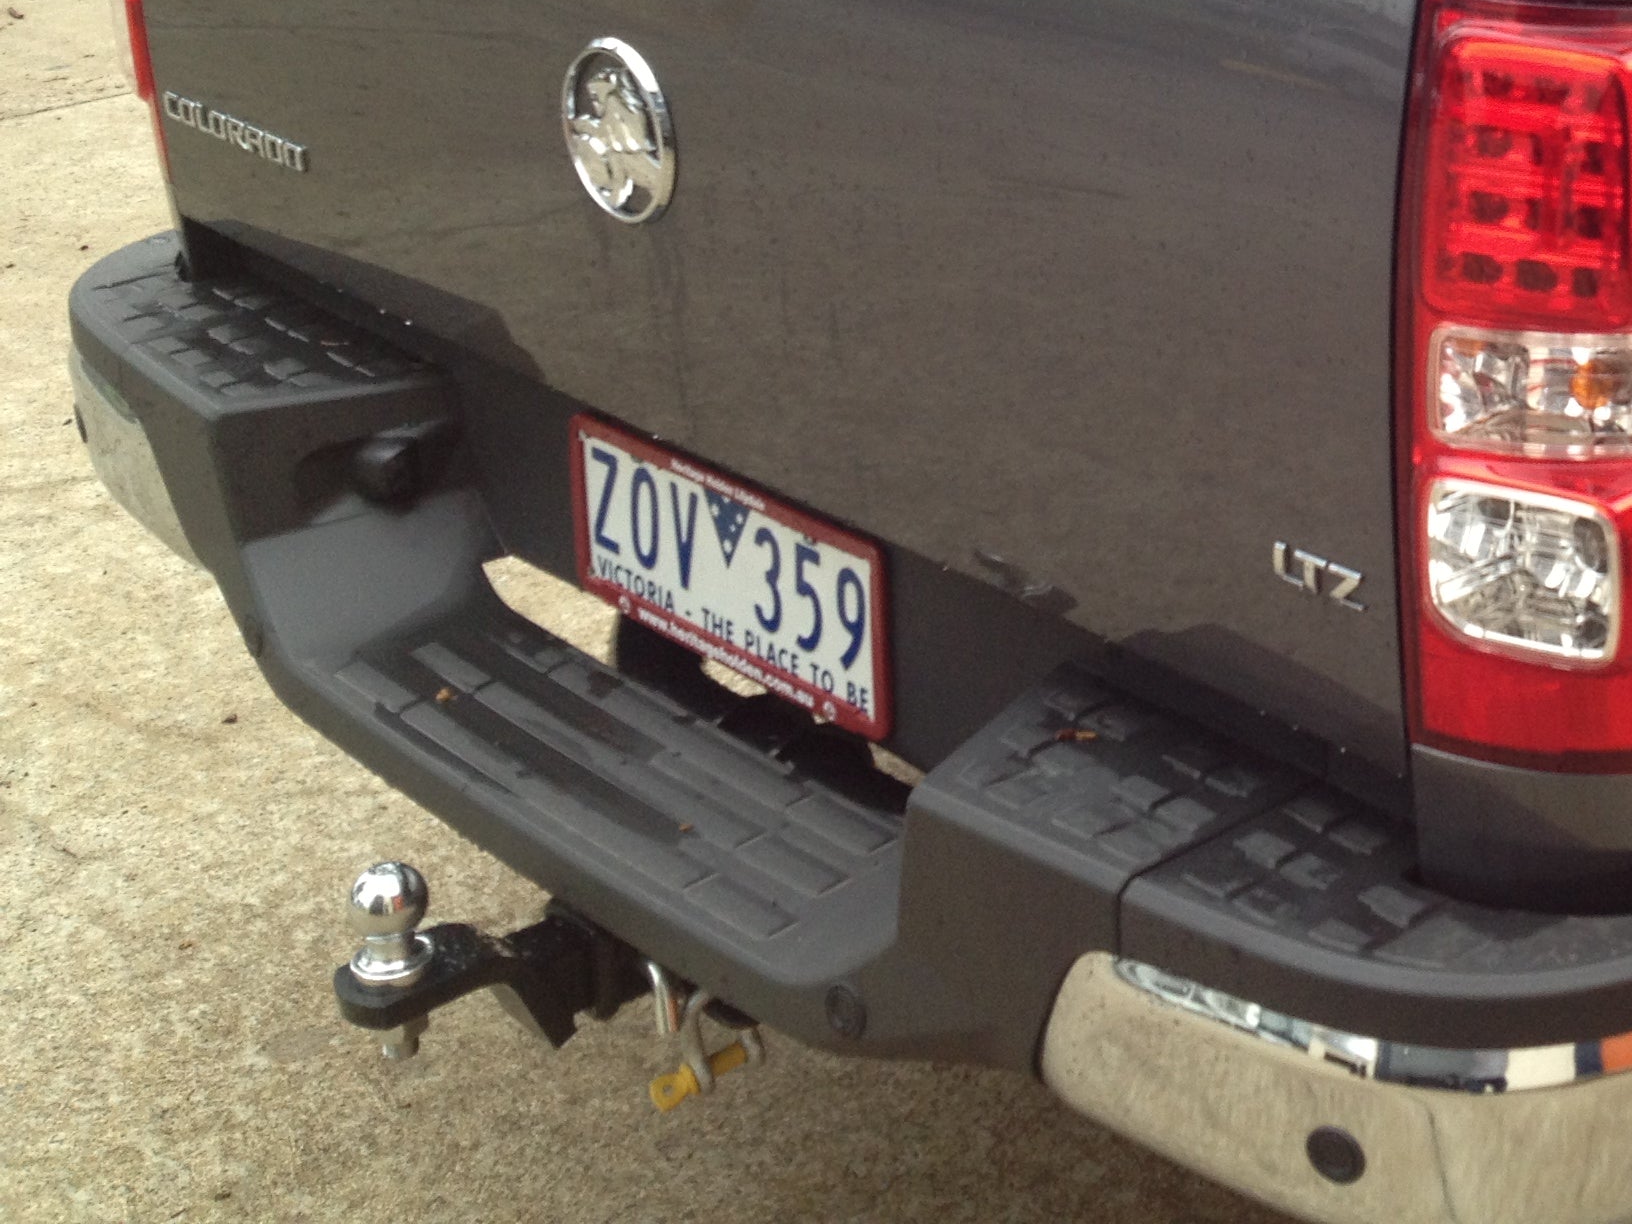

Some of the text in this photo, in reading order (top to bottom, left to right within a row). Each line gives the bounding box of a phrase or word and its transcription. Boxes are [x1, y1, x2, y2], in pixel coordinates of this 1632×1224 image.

[163, 91, 306, 172] COLORADO
[591, 446, 867, 671] ZOV 359
[1272, 541, 1364, 612] LTZ
[597, 555, 676, 614] VICTORIA
[701, 607, 734, 645] THE
[744, 629, 799, 679] PLACE
[810, 662, 835, 694] TO
[846, 681, 869, 714] BE
